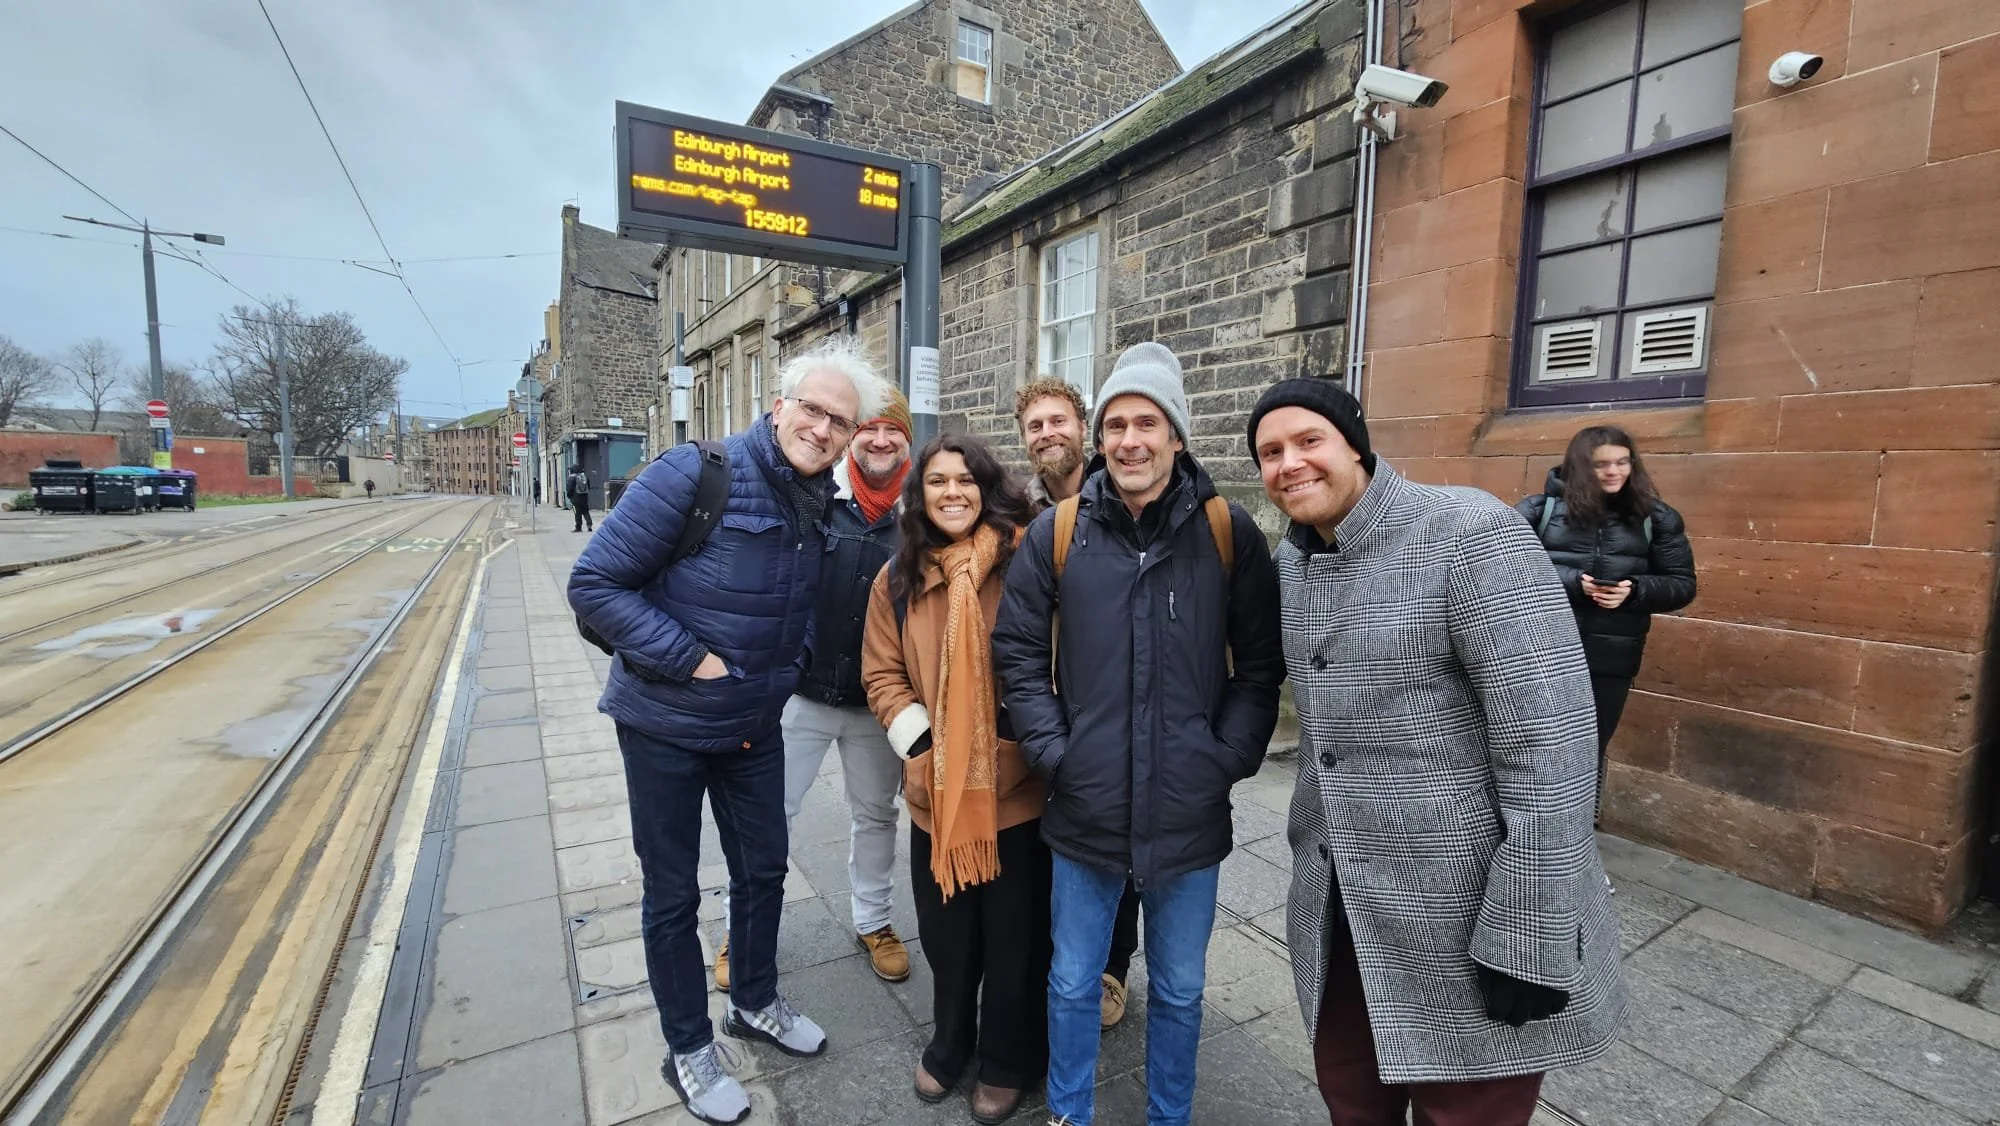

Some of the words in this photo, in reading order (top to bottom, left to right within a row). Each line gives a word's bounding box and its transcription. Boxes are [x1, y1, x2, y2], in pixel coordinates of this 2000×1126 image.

[674, 130, 741, 161] Edinburgh
[743, 143, 790, 167] Airport
[863, 167, 873, 184] 2
[873, 172, 899, 188] mins
[674, 154, 741, 184] Edinburgh
[743, 166, 790, 190] Airport
[859, 188, 872, 205] 18
[873, 193, 898, 209] mins
[745, 208, 808, 235] 15:59:12
